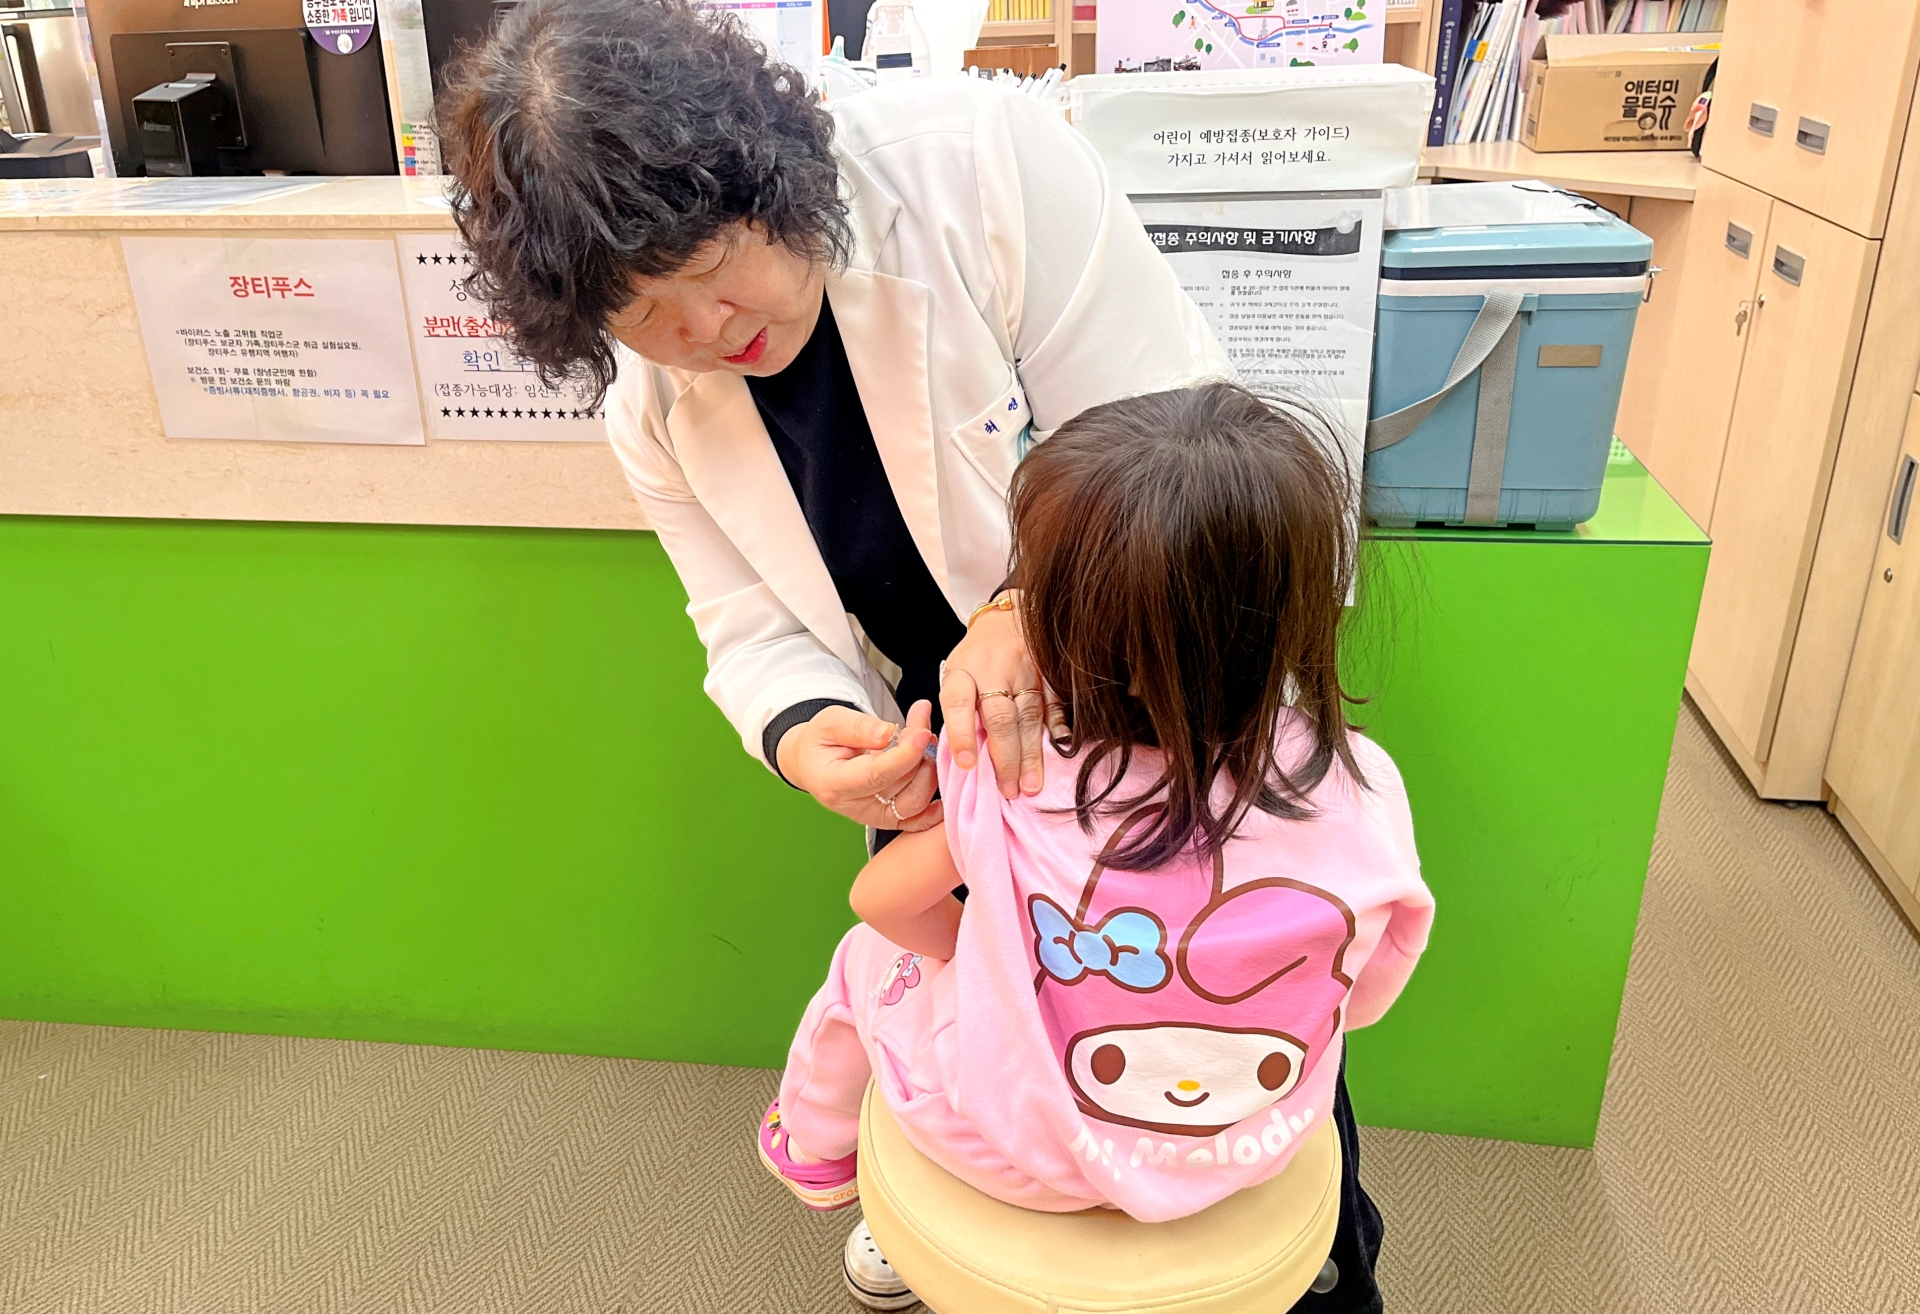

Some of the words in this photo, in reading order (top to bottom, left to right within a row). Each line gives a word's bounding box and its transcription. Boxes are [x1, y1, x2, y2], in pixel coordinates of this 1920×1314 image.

[307, 9, 330, 24] 소중한
[331, 8, 348, 23] 가족
[348, 7, 373, 22] 입니다
[1624, 79, 1680, 95] 애터미
[1622, 95, 1677, 131] 물티슈
[1153, 130, 1192, 145] 어린이
[1199, 127, 1298, 145] 예방접종(보호자
[1304, 125, 1350, 141] 가이드)
[1167, 152, 1207, 167] 가지고
[1213, 151, 1253, 166] 가셔서
[1261, 149, 1331, 165] 읽어보세요.
[1184, 231, 1239, 246] 주의사항
[1243, 231, 1257, 246] 및
[1261, 230, 1317, 246] 금기사항
[1221, 269, 1239, 279] 접종
[1243, 269, 1252, 279] 후
[1255, 269, 1292, 279] 주의사항
[229, 275, 315, 299] 장티푸스
[180, 328, 211, 338] 바이러스
[214, 329, 230, 338] 노출
[234, 329, 257, 339] 고위험
[260, 330, 284, 339] 직업군
[184, 338, 217, 347] (장티푸스
[220, 339, 243, 348] 보균자
[303, 340, 319, 349] 취급
[207, 348, 238, 357] 장티푸스
[240, 348, 270, 358] 유행지역
[273, 349, 299, 358] 여행자)
[462, 350, 502, 372] 확인
[187, 366, 210, 375] 보건소
[233, 367, 250, 376] 무료
[299, 368, 317, 378] 한함)
[200, 376, 216, 385] 방문
[219, 376, 227, 386] 전
[230, 377, 253, 386] 보건소
[256, 378, 272, 387] 문의
[275, 378, 291, 387] 바람
[324, 389, 341, 399] 비자
[344, 389, 357, 399] 등)
[360, 389, 369, 399] 꼭
[373, 389, 390, 399] 필요
[434, 382, 518, 398] (접종가능대상:
